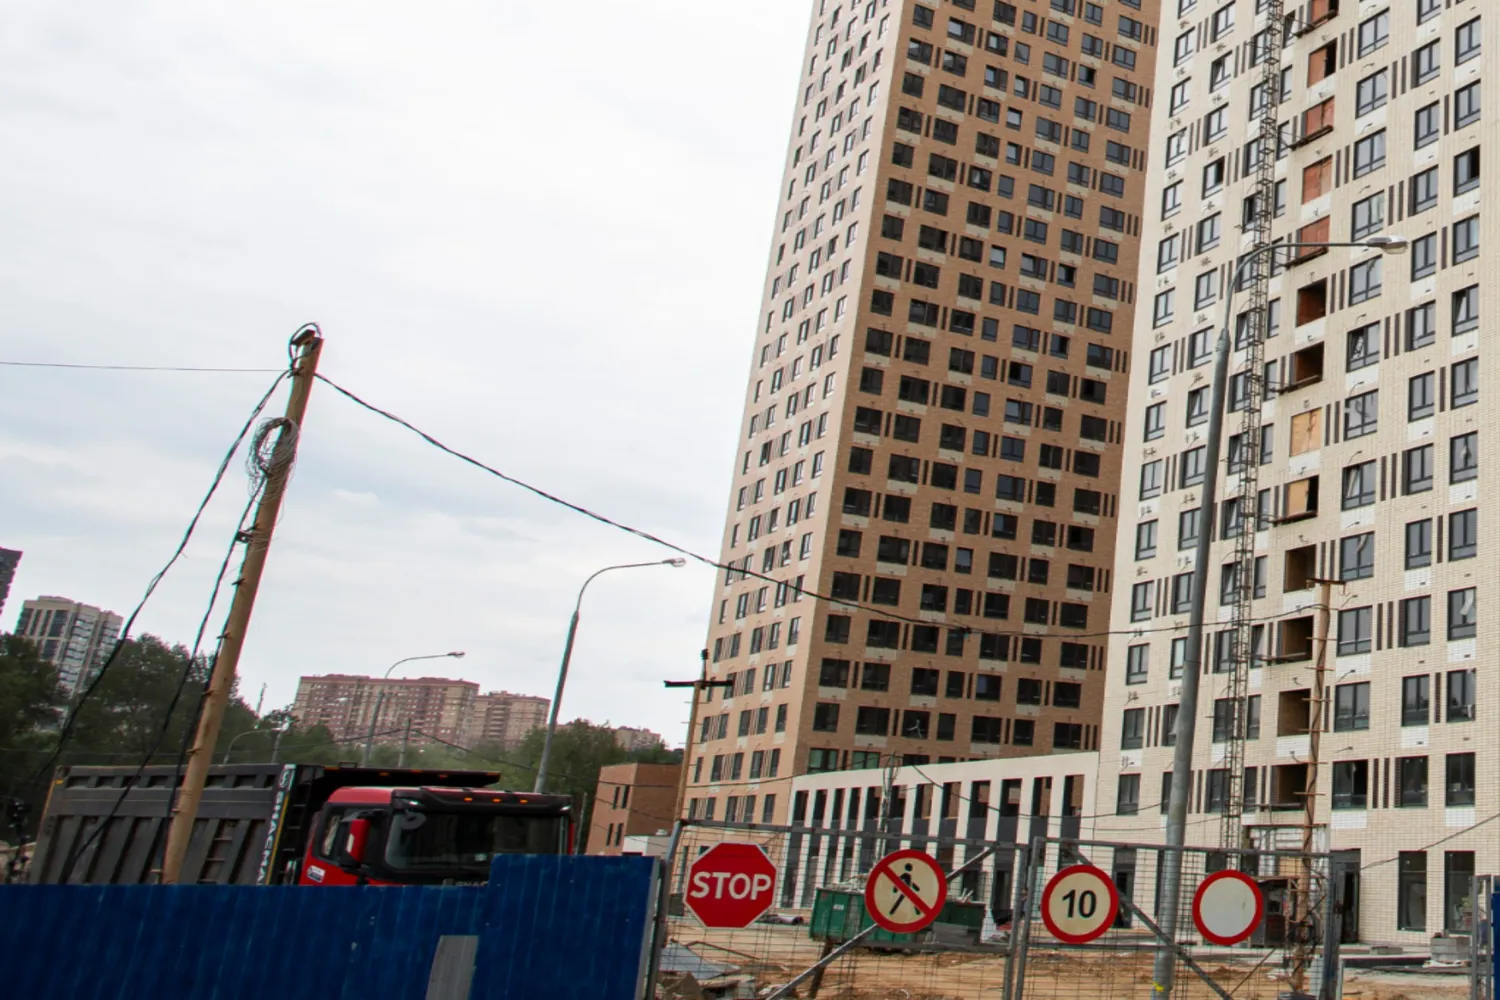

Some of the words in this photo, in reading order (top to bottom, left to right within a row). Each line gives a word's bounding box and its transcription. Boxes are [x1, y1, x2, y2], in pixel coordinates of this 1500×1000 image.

[255, 790, 284, 886] SHACMA
[689, 871, 772, 901] STOP
[1062, 889, 1097, 919] 10
